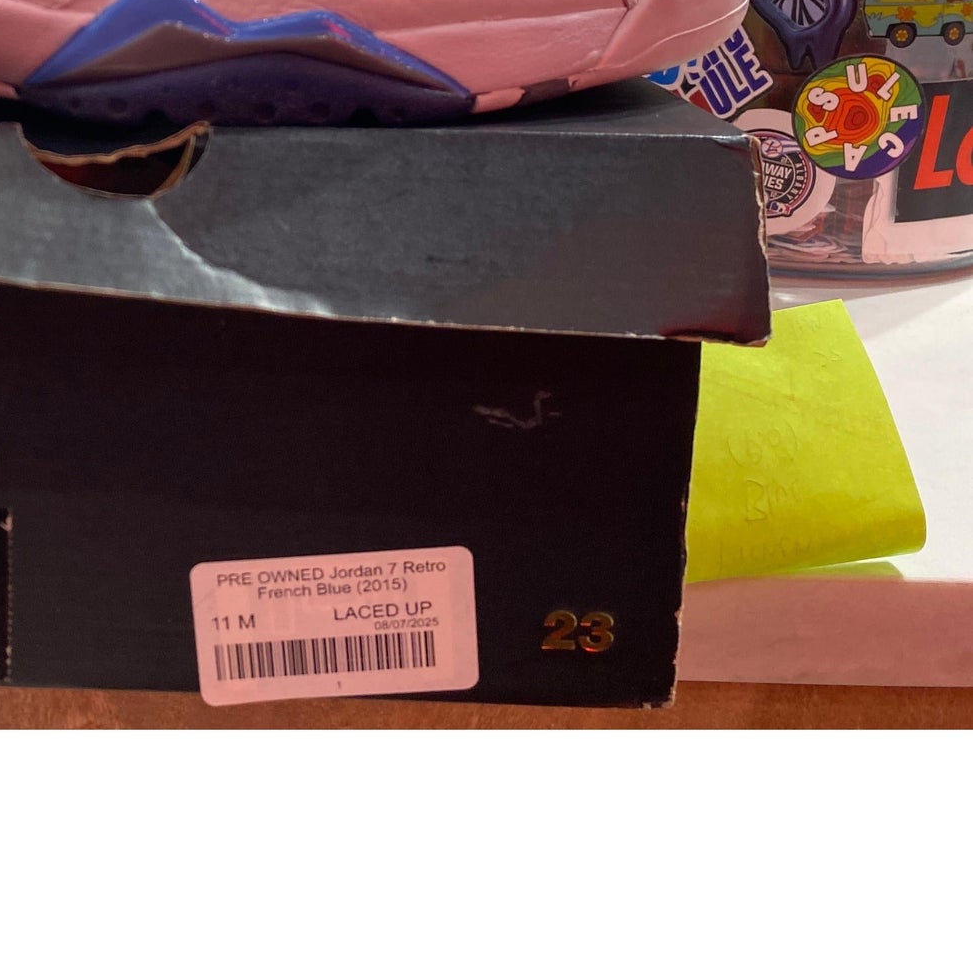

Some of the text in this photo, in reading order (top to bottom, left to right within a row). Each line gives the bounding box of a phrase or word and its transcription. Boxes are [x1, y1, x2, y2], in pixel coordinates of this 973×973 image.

[764, 162, 792, 179] WAY
[217, 560, 446, 586] PRE OWNED Jordan 7 Retro
[257, 578, 408, 599] French Blue (2015)
[333, 600, 433, 621] LACED UP
[212, 614, 256, 630] 11 M
[374, 616, 439, 630] 08/07/2025
[541, 610, 615, 652] 23
